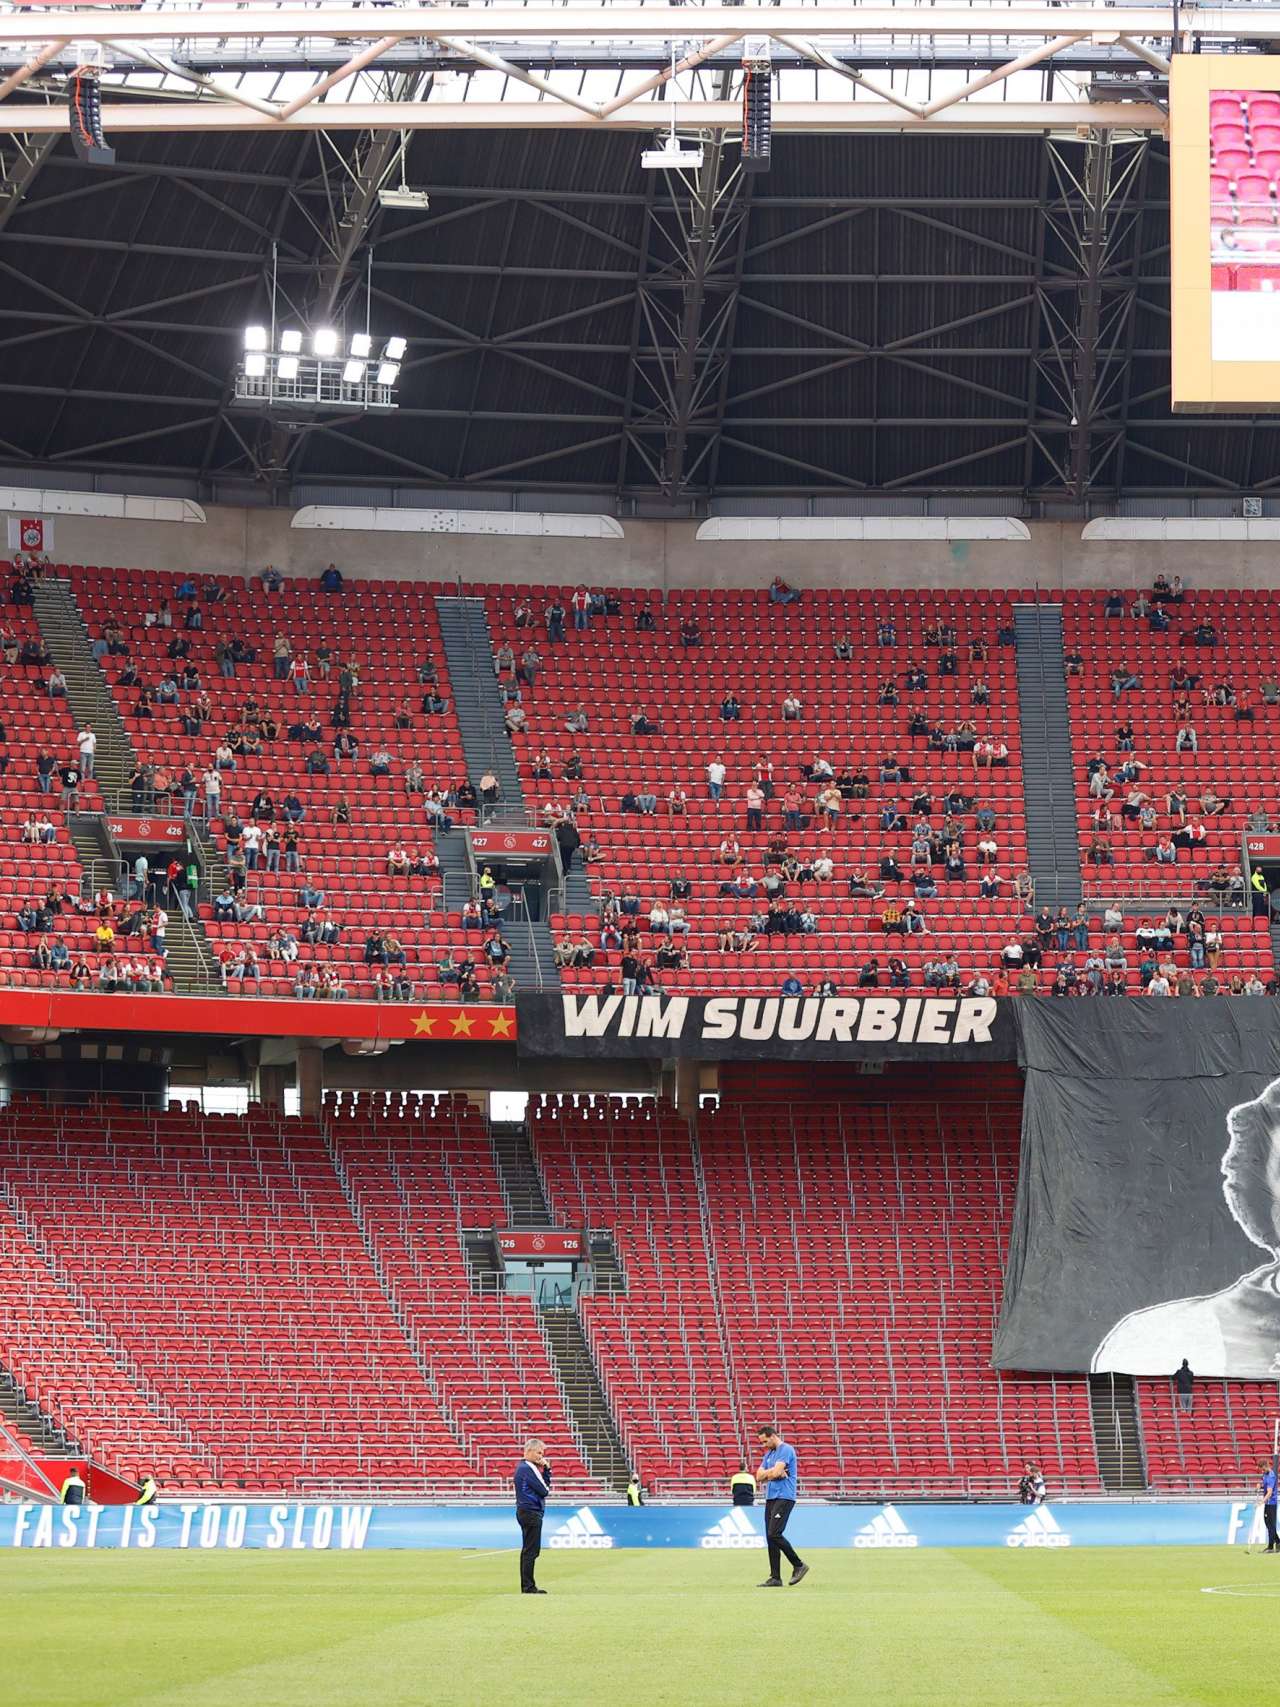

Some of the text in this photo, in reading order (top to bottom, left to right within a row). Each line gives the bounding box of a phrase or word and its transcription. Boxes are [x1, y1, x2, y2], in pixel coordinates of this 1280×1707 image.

[166, 827, 183, 836] 426
[472, 838, 488, 847] 427
[532, 839, 548, 848] 427
[1248, 842, 1265, 851] 428
[562, 994, 998, 1044] WIM SUURBIER
[500, 1239, 516, 1249] 126
[562, 1239, 579, 1249] 126
[14, 1505, 372, 1549] FAST IS TOO SLOW
[549, 1533, 613, 1549] adidas
[701, 1533, 765, 1549] adidas
[853, 1532, 918, 1548] adidas
[1006, 1532, 1071, 1548] adidas
